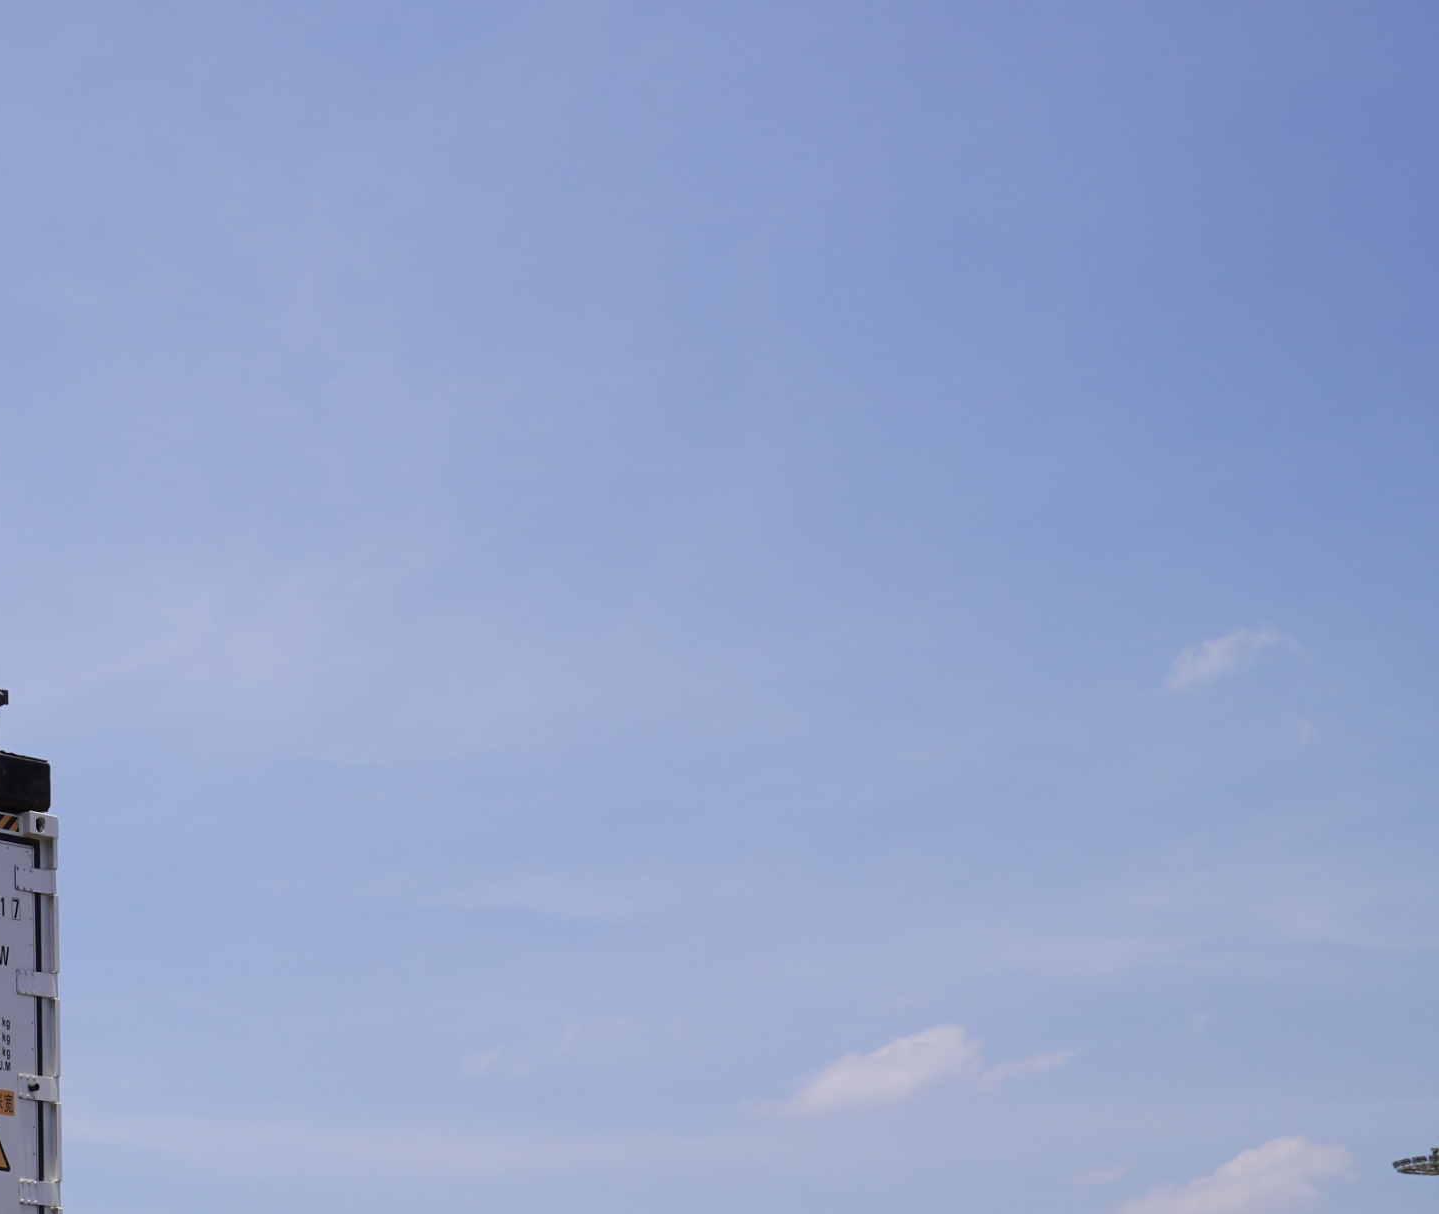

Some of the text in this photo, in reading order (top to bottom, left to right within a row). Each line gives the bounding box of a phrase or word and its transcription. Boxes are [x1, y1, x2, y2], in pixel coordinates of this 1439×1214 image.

[13, 899, 20, 919] 7
[2, 1017, 11, 1031] kg
[2, 1032, 11, 1046] kg
[2, 1046, 11, 1060] kg
